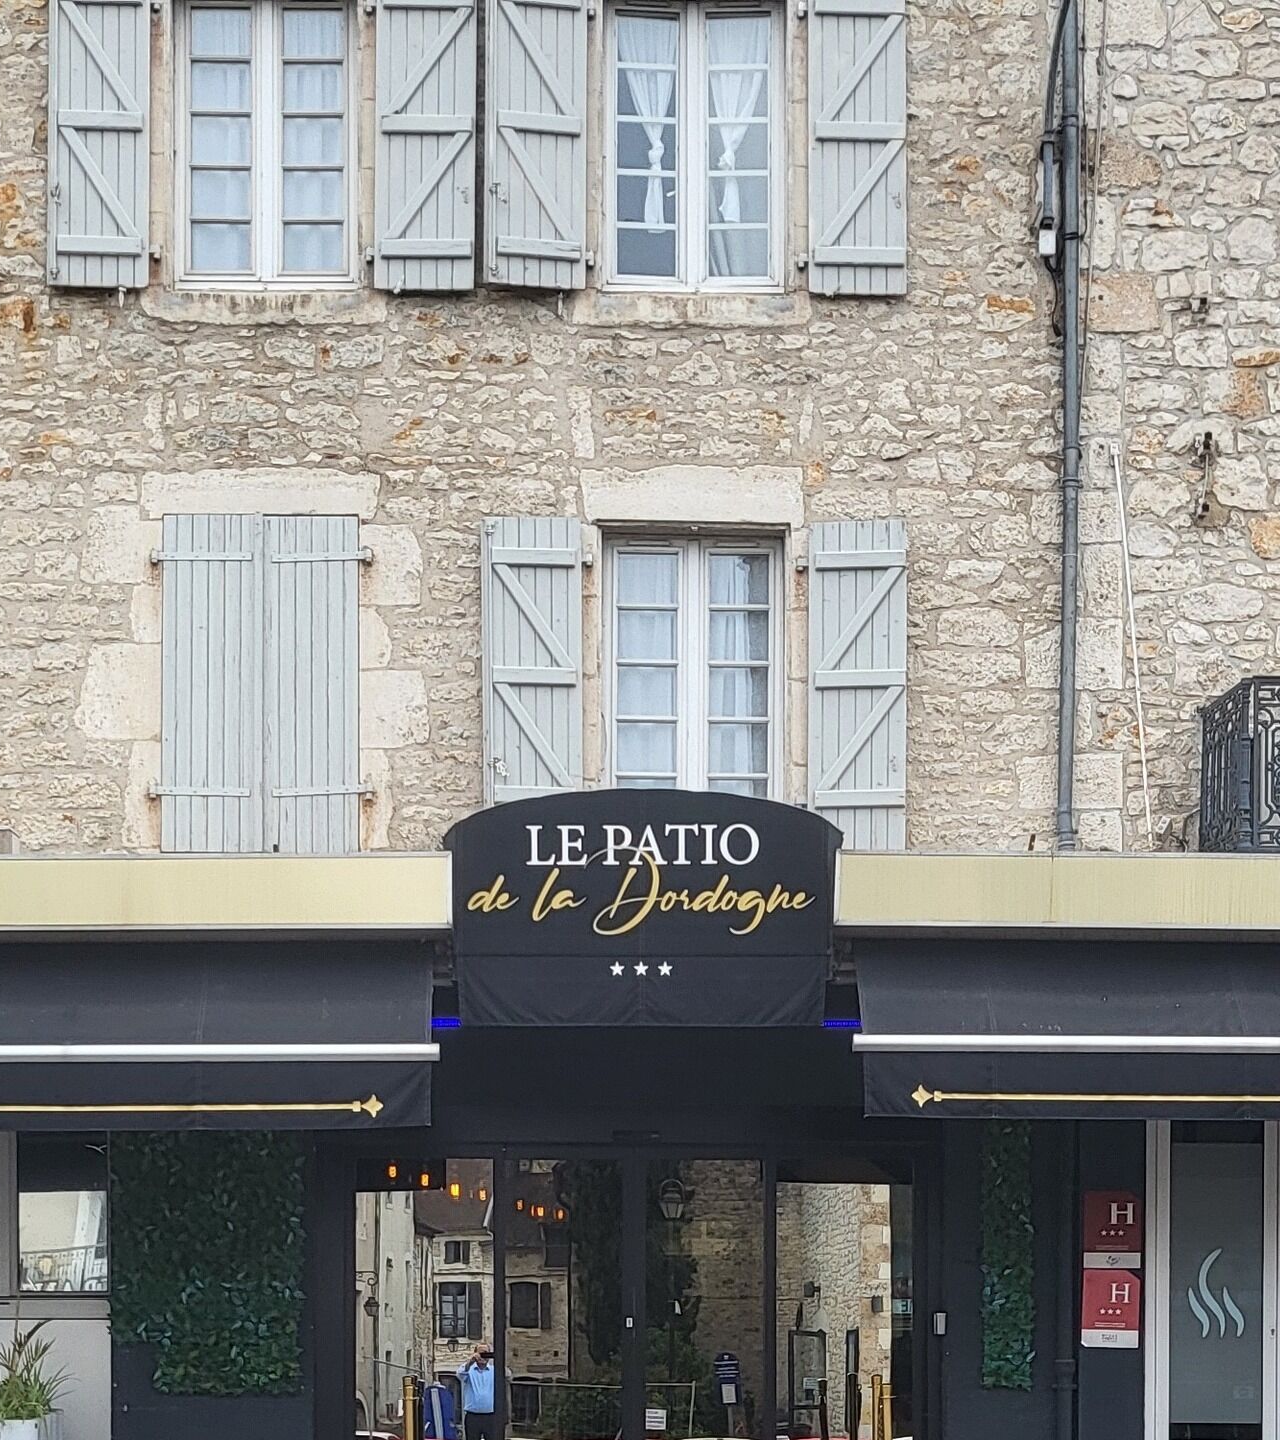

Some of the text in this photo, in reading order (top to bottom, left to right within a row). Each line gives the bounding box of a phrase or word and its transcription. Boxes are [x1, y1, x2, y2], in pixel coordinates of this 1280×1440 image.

[525, 823, 760, 866] LE PATIO
[467, 846, 816, 936] de la Dordogne
[1110, 1202, 1135, 1225] H
[1110, 1282, 1131, 1304] H
